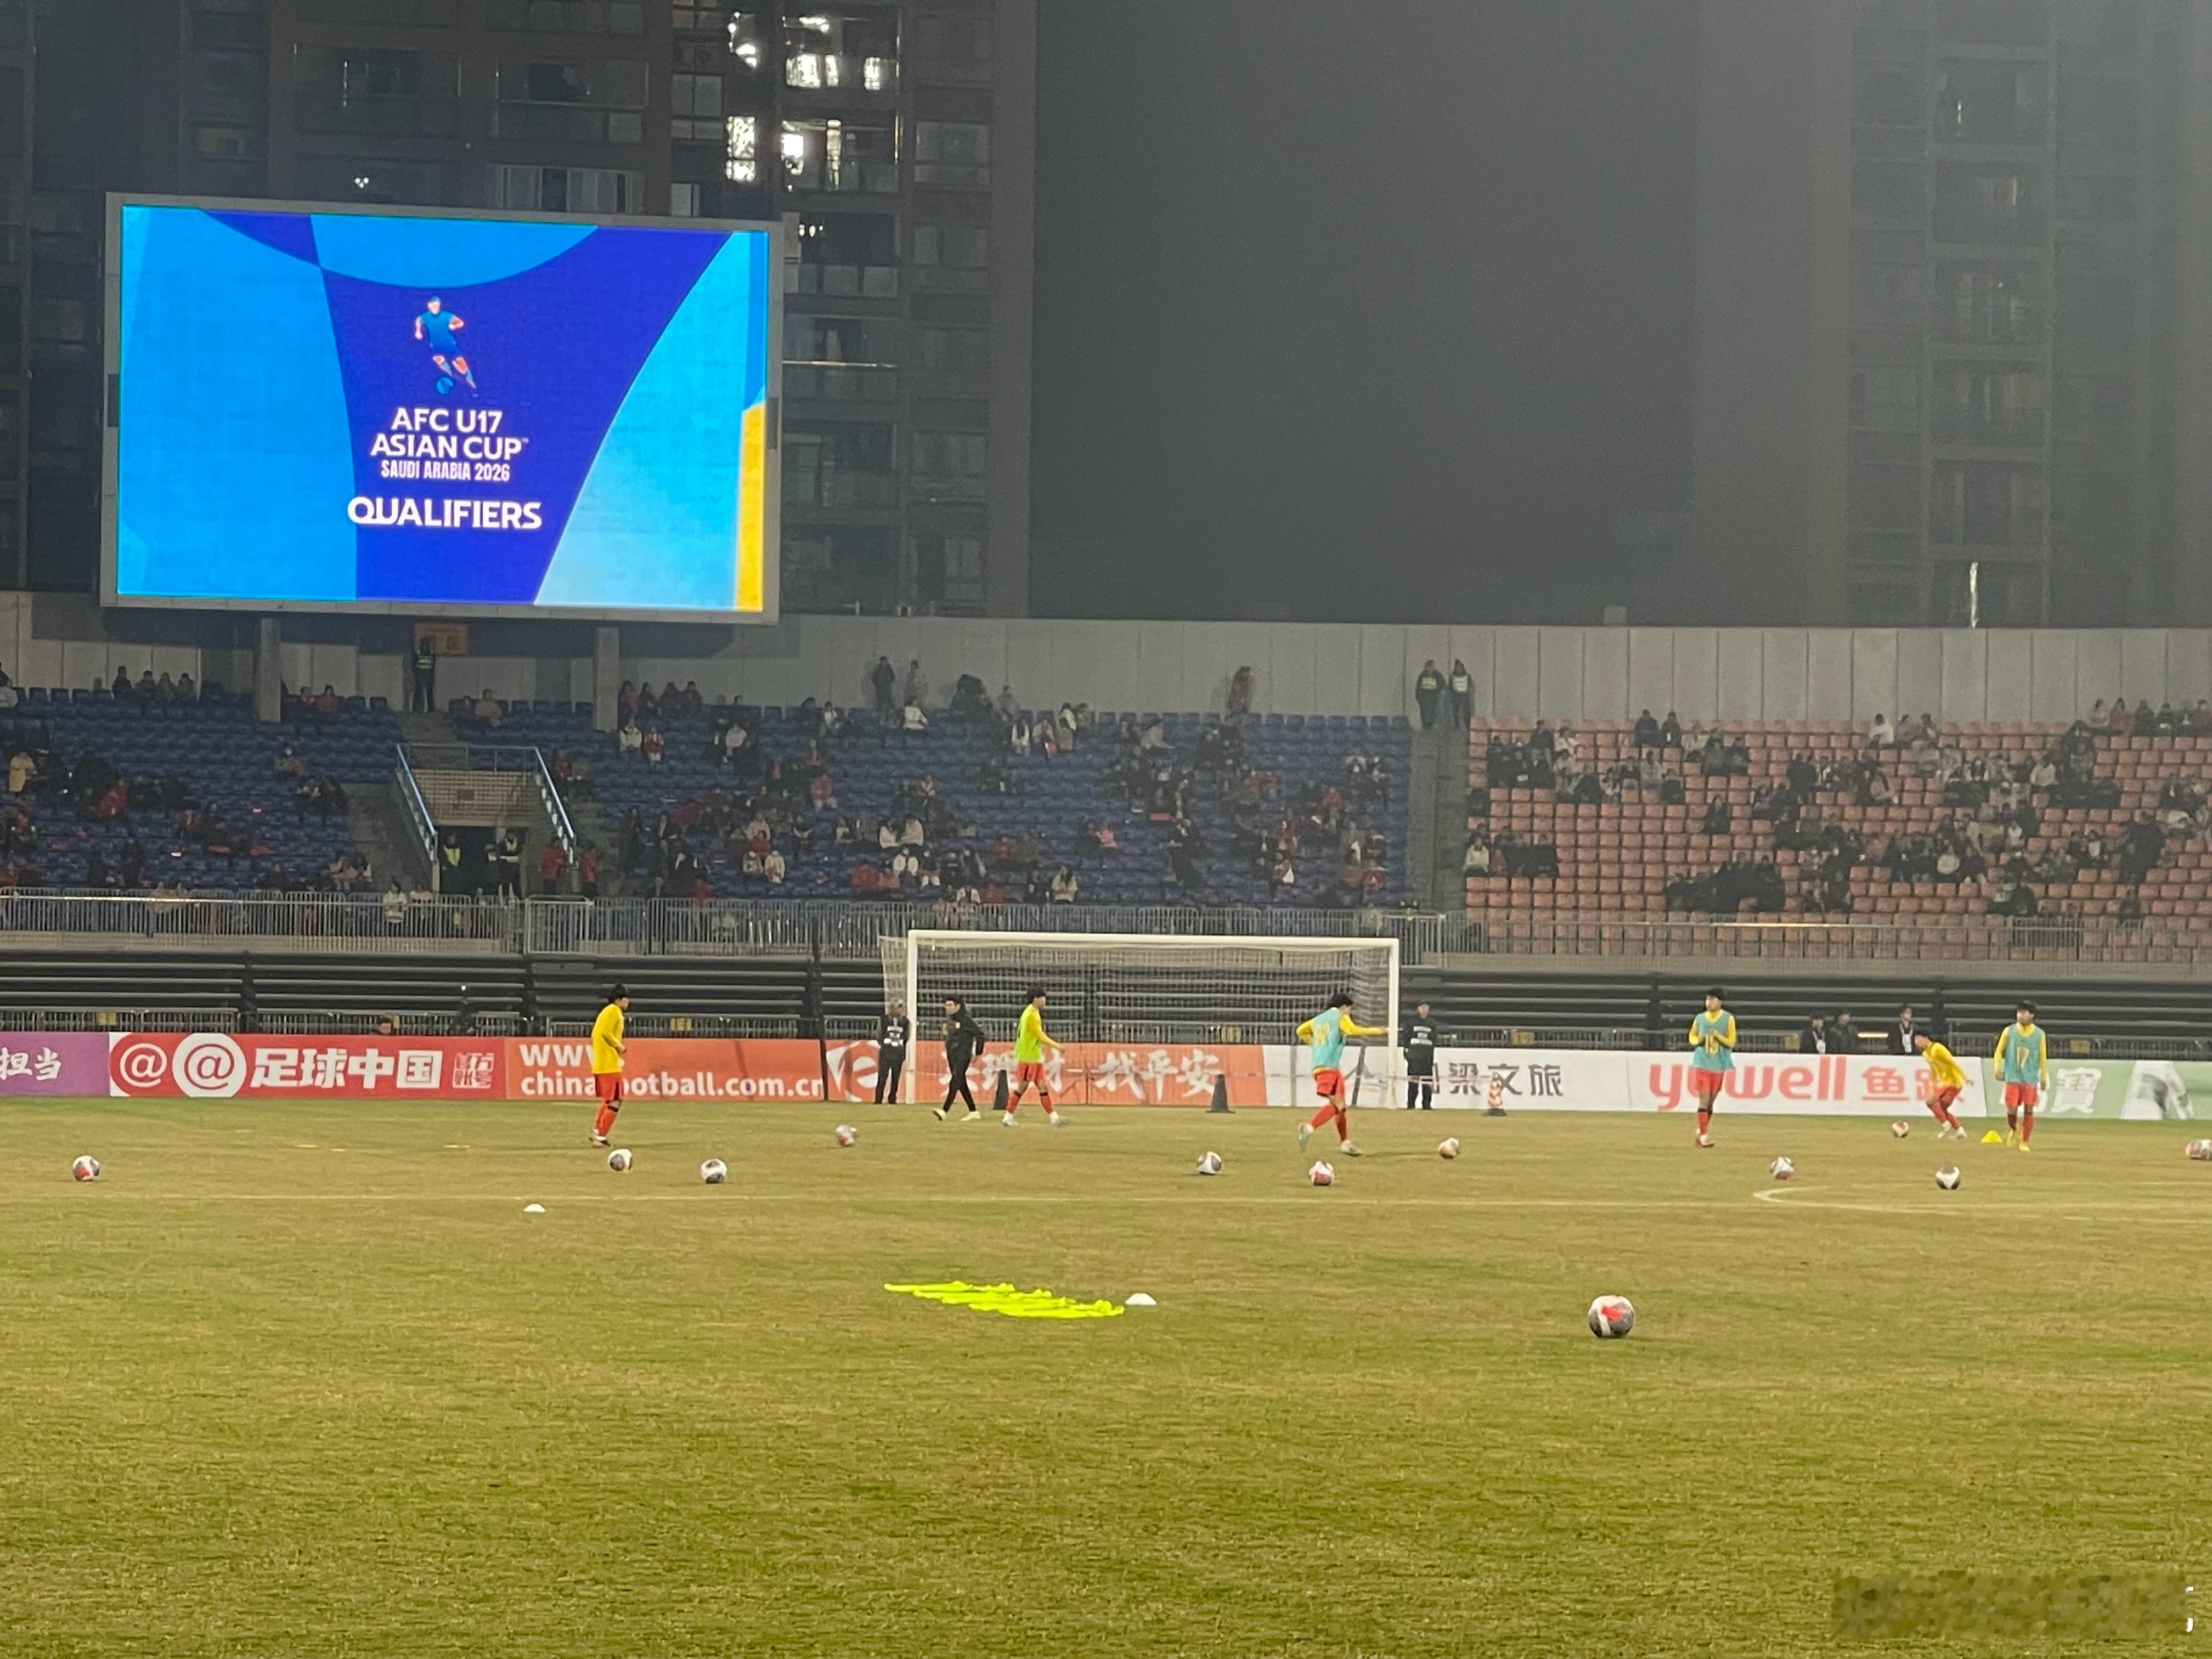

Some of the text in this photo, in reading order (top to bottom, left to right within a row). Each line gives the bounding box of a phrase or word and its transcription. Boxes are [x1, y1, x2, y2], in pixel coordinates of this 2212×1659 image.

[391, 408, 503, 433] AFC U17
[370, 433, 521, 460] ASIAN CUP
[381, 460, 510, 481] SAUDI ARABIA 2026
[347, 496, 542, 529] QUALIFIERS
[0, 1047, 62, 1080] 担当
[250, 1048, 443, 1089] 足球中国
[521, 1070, 823, 1096] chinaotball.com.cn
[1432, 1062, 1564, 1097] 梁文旅
